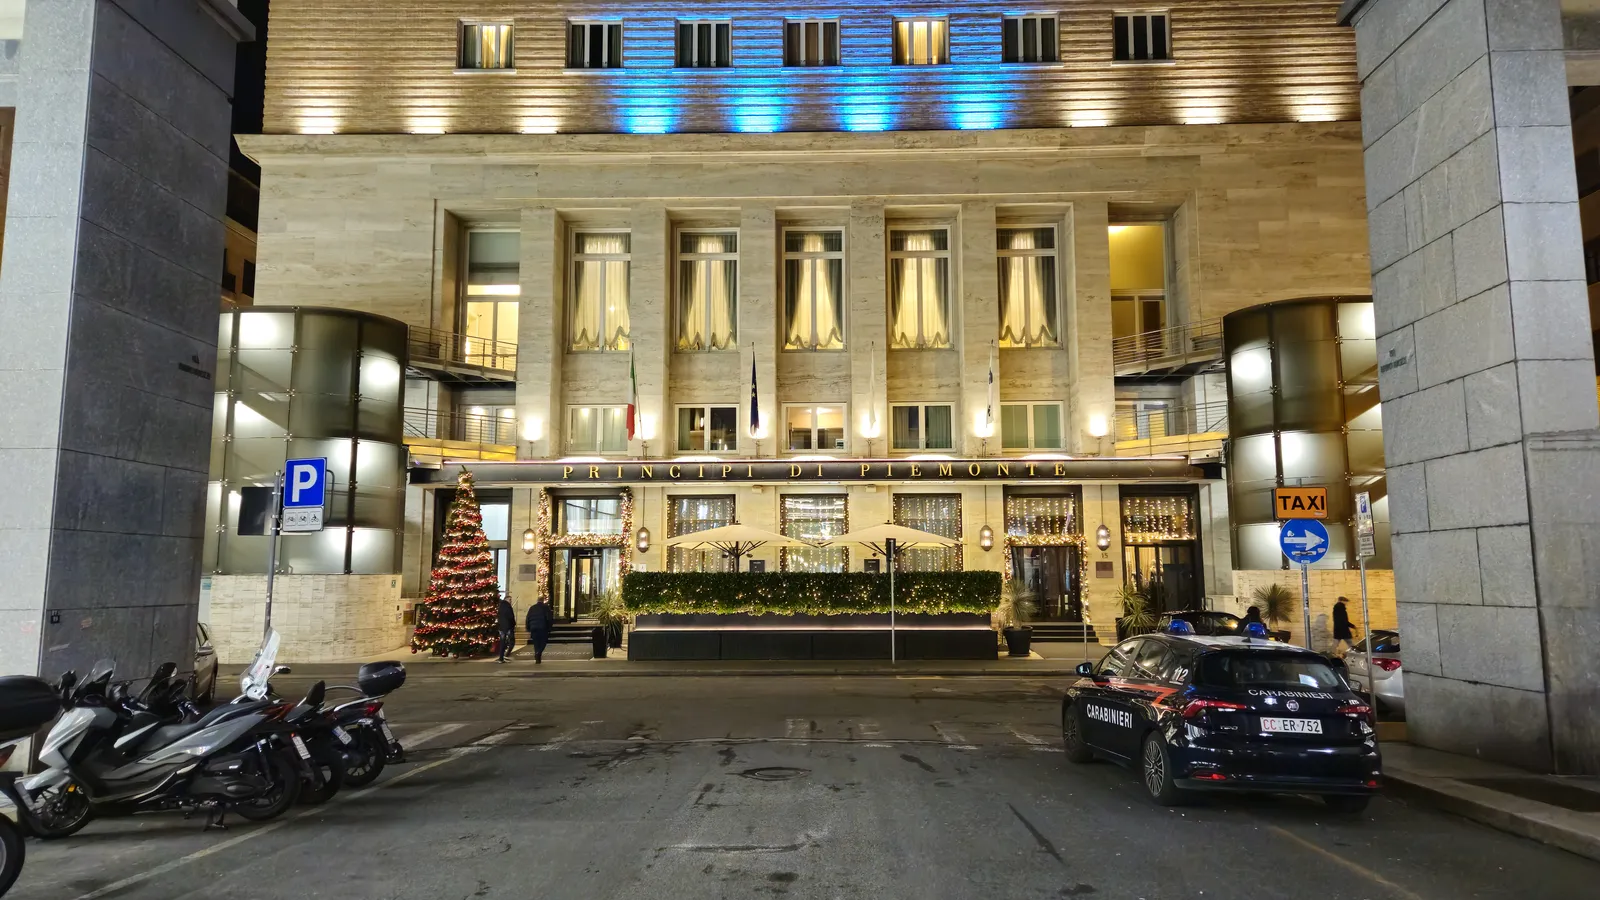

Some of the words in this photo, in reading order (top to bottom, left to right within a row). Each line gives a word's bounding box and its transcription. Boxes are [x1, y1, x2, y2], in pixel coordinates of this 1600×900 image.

[562, 464, 754, 480] PRINCIPI
[790, 463, 824, 478] DI
[860, 463, 1066, 478] PIEMONTE
[1277, 495, 1326, 512] TAXI
[1172, 665, 1189, 682] 112
[1248, 689, 1334, 699] CARABINIERI
[1086, 703, 1133, 729] CARABINIERI
[1263, 718, 1277, 730] CC
[1282, 719, 1297, 731] ER
[1300, 720, 1320, 733] 752
